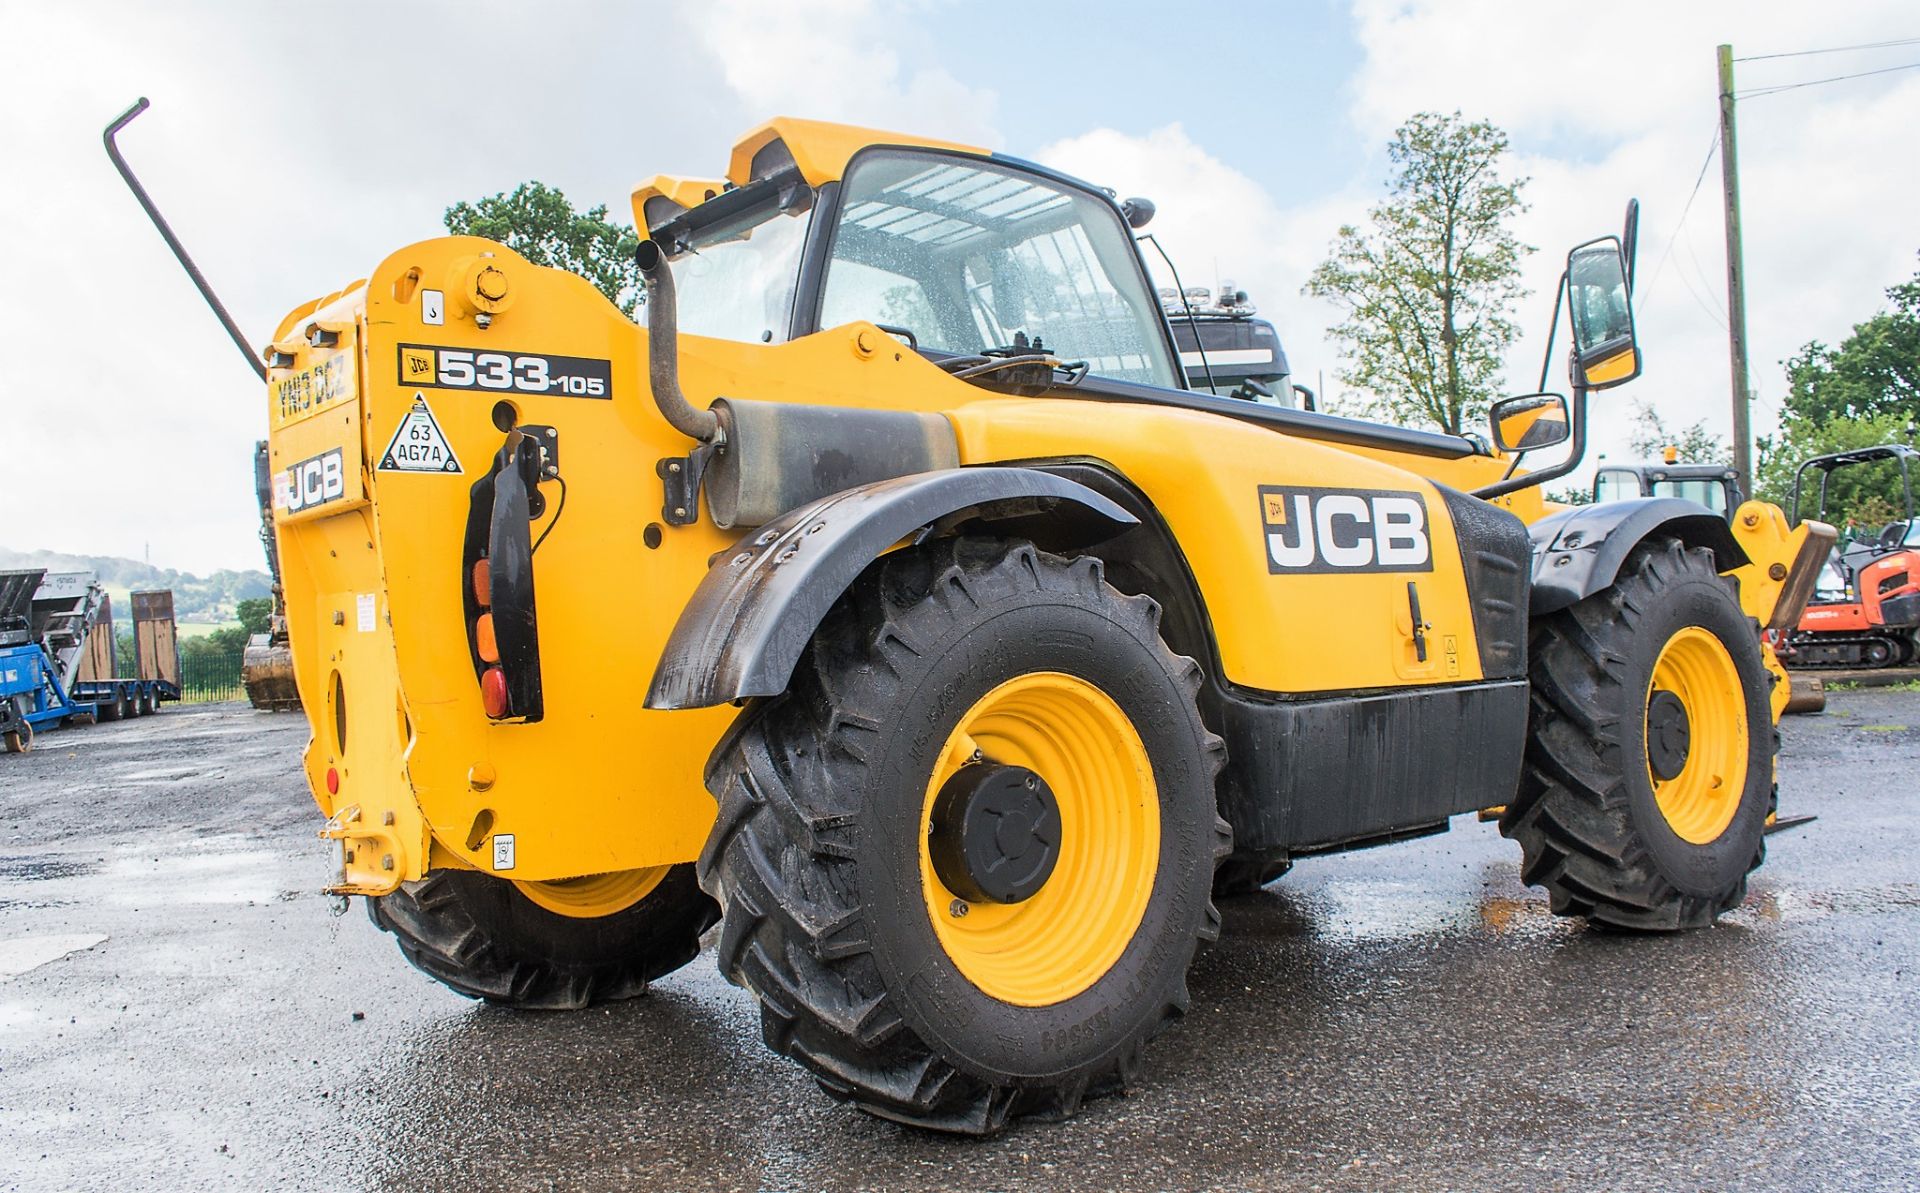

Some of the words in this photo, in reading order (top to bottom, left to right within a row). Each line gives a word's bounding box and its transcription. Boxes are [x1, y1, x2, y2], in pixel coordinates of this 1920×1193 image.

[438, 350, 605, 396] 533-105
[398, 444, 442, 462] AG7A
[410, 424, 431, 441] 63
[288, 453, 344, 510] JCB
[1268, 494, 1429, 567] JCB
